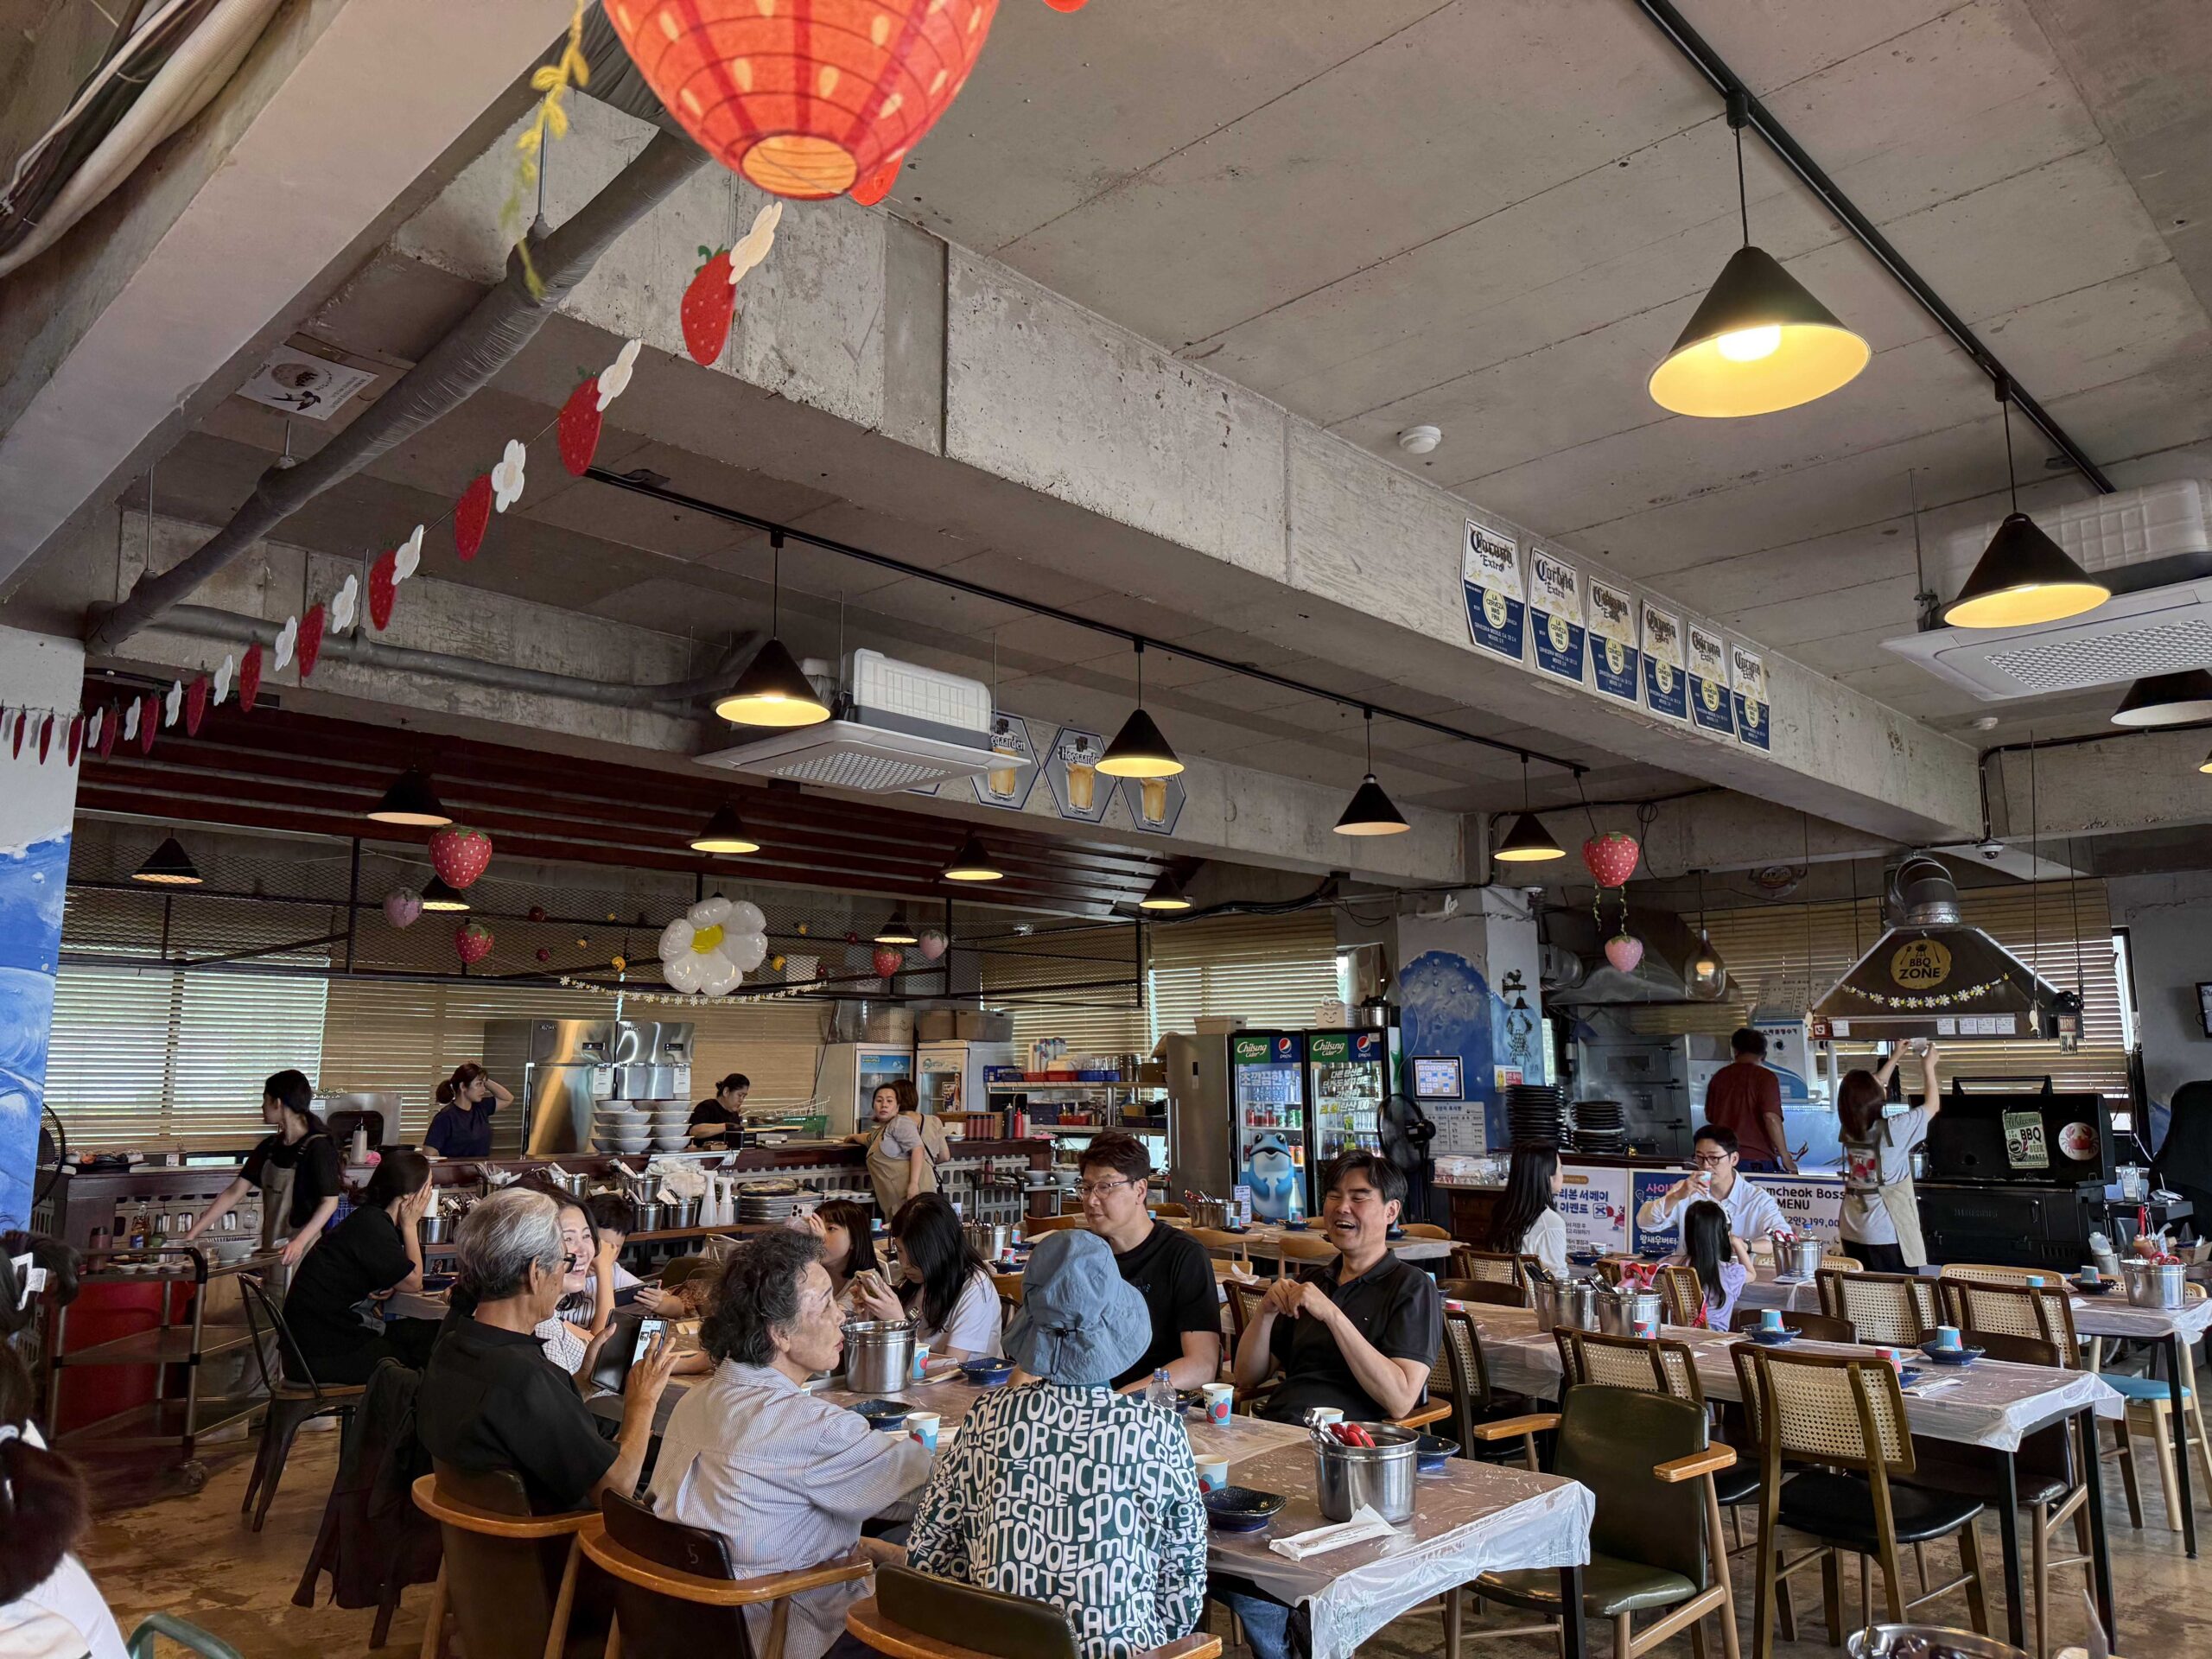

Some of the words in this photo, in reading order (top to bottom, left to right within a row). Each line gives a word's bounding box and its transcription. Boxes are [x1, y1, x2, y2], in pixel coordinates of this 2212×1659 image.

[1471, 531, 1514, 568] Corona
[1535, 559, 1574, 594] Corona
[1545, 582, 1565, 599] Extra
[1910, 957, 1931, 967] BBQ
[1898, 968, 1941, 979] ZONE
[1237, 1041, 1267, 1055] Chilsung
[1313, 1039, 1345, 1054] Chilsung
[2020, 1127, 2041, 1142] BBQ
[1579, 1189, 1609, 1202] 서베이
[1816, 1188, 1846, 1200] Boss
[1560, 1202, 1589, 1214] 이벤트
[1639, 1234, 1679, 1245] 왕새우버터
